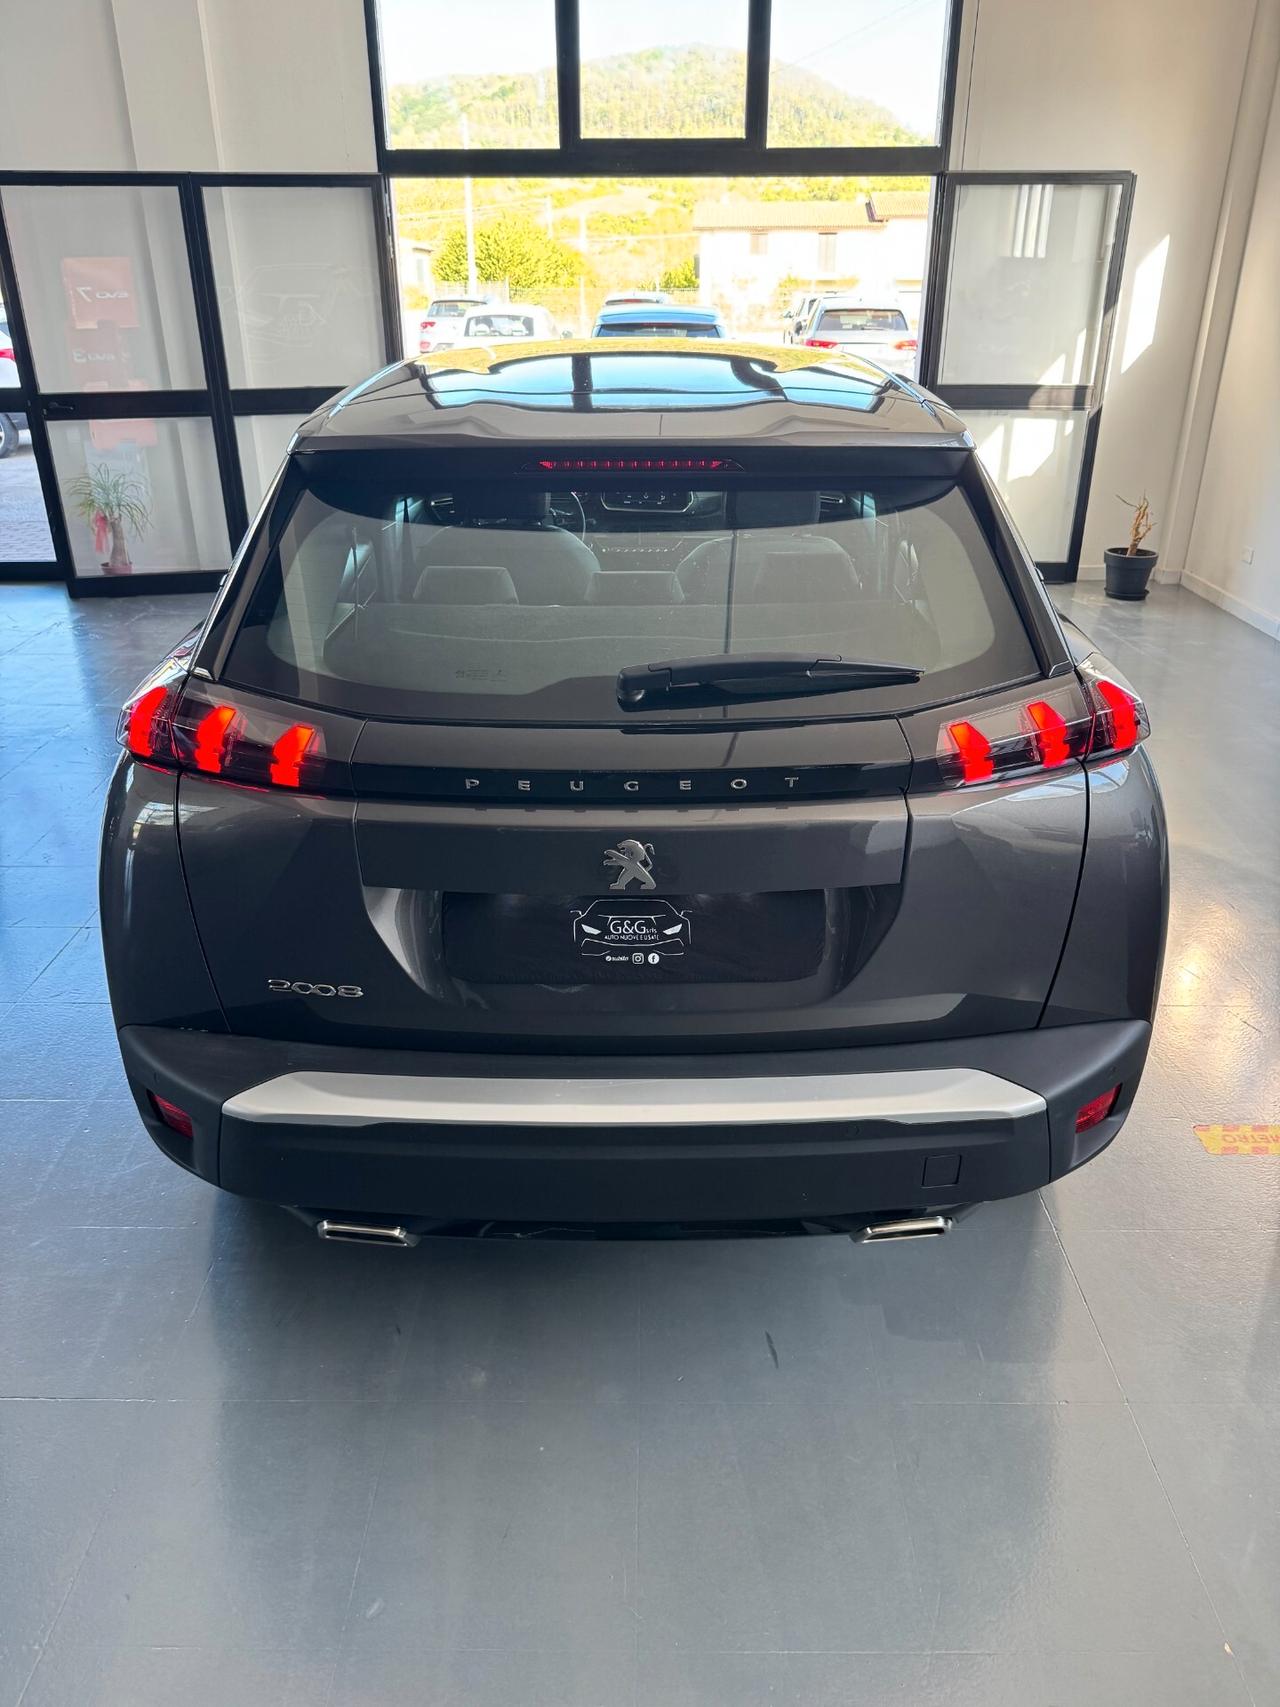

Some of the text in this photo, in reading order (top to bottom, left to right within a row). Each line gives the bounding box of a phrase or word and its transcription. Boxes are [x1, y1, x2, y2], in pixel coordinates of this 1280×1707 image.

[465, 776, 800, 792] PEUGEOT
[610, 920, 646, 935] G&G
[267, 979, 364, 998] 2008
